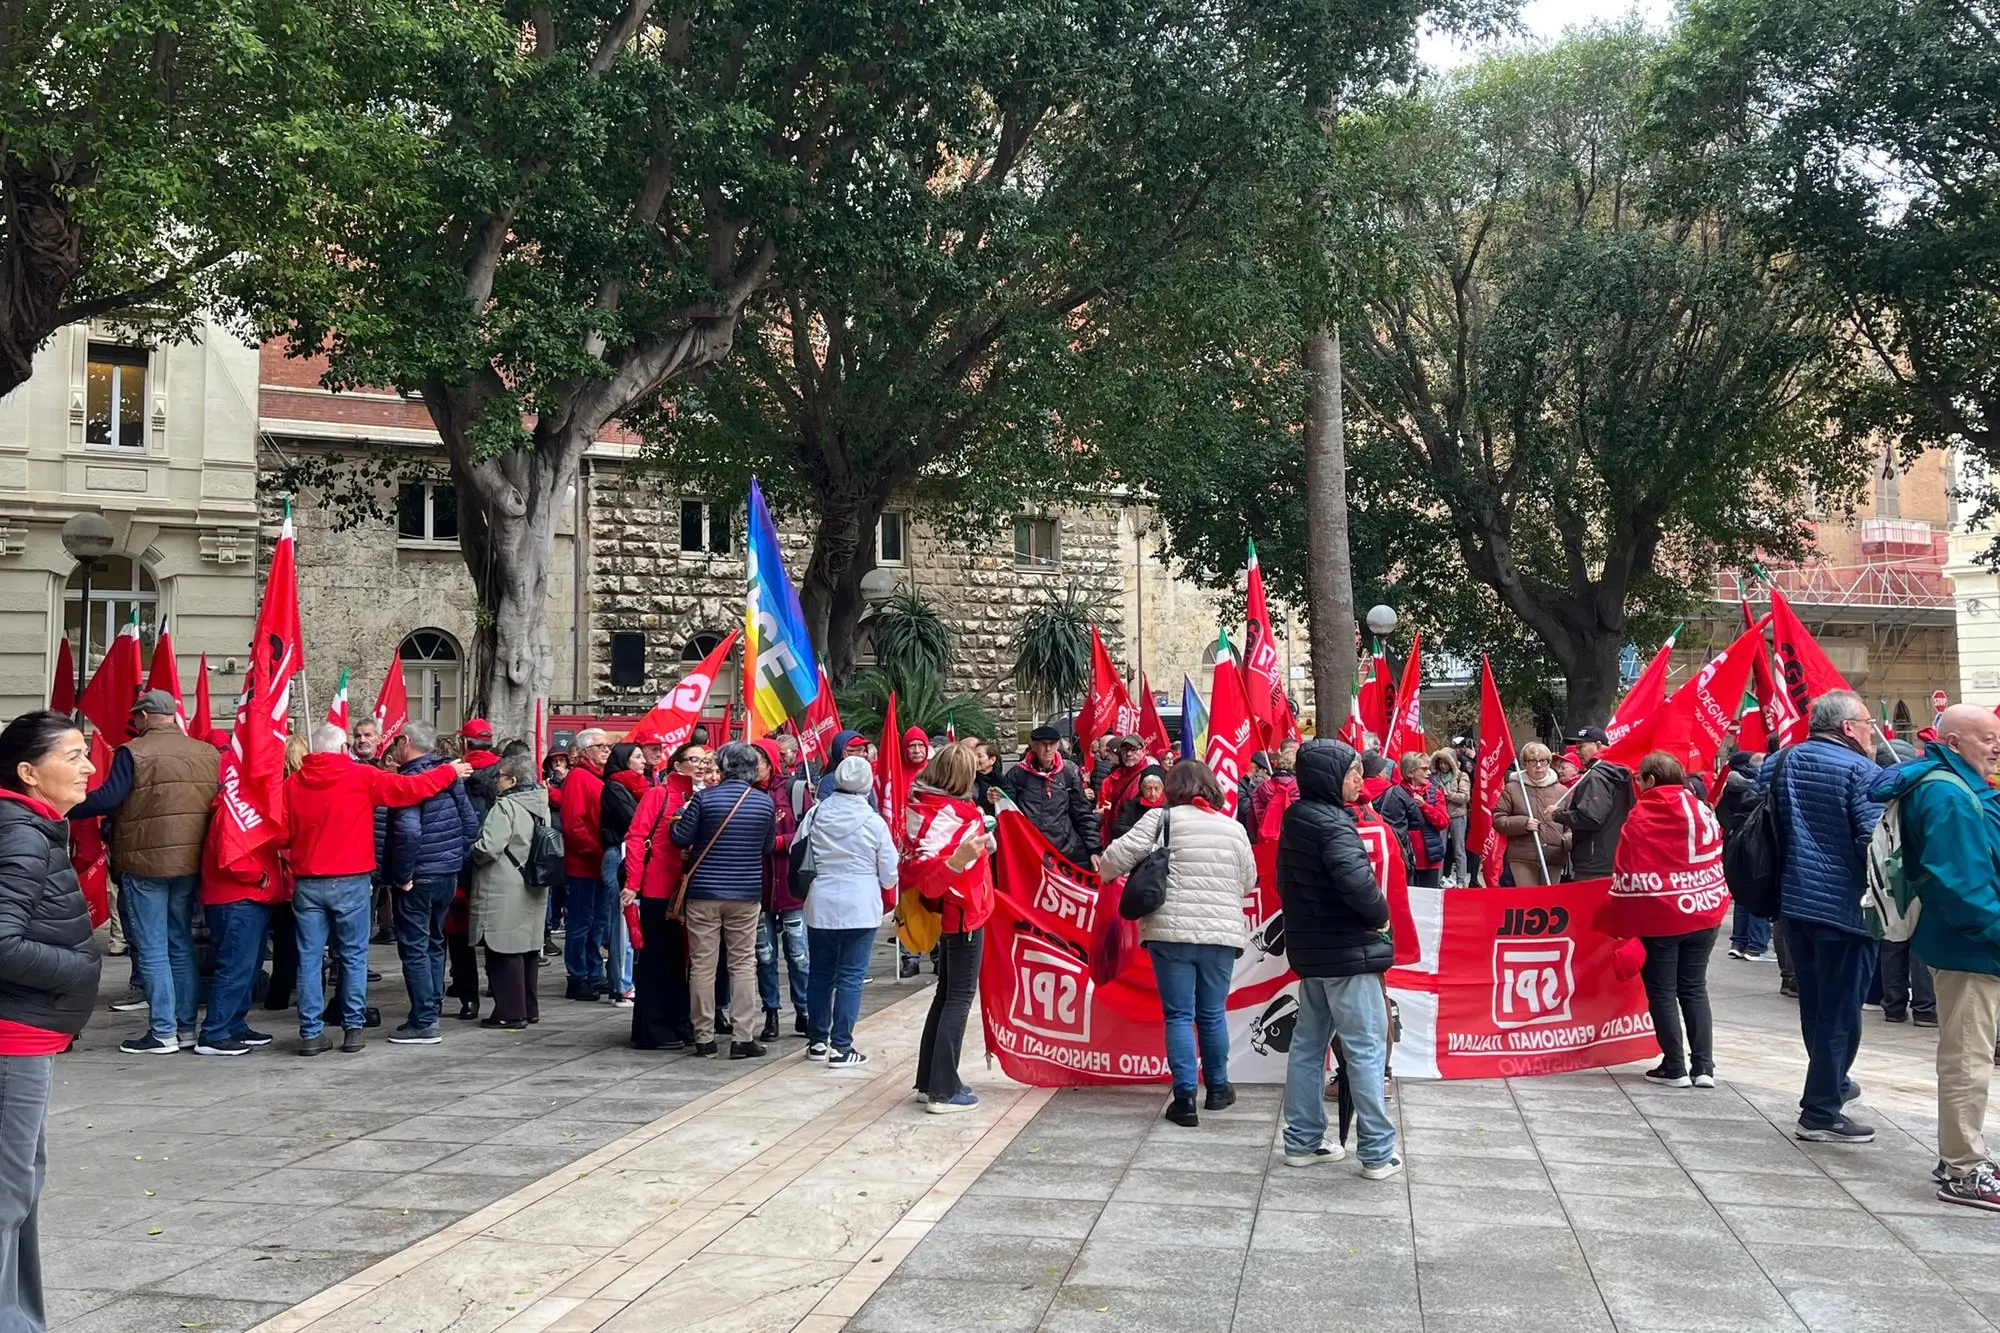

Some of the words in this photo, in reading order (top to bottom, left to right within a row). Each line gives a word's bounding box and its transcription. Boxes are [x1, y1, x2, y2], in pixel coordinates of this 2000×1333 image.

[1780, 643, 1810, 716] CGIL
[1933, 697, 1947, 706] STOP
[1041, 886, 1088, 932] SPI
